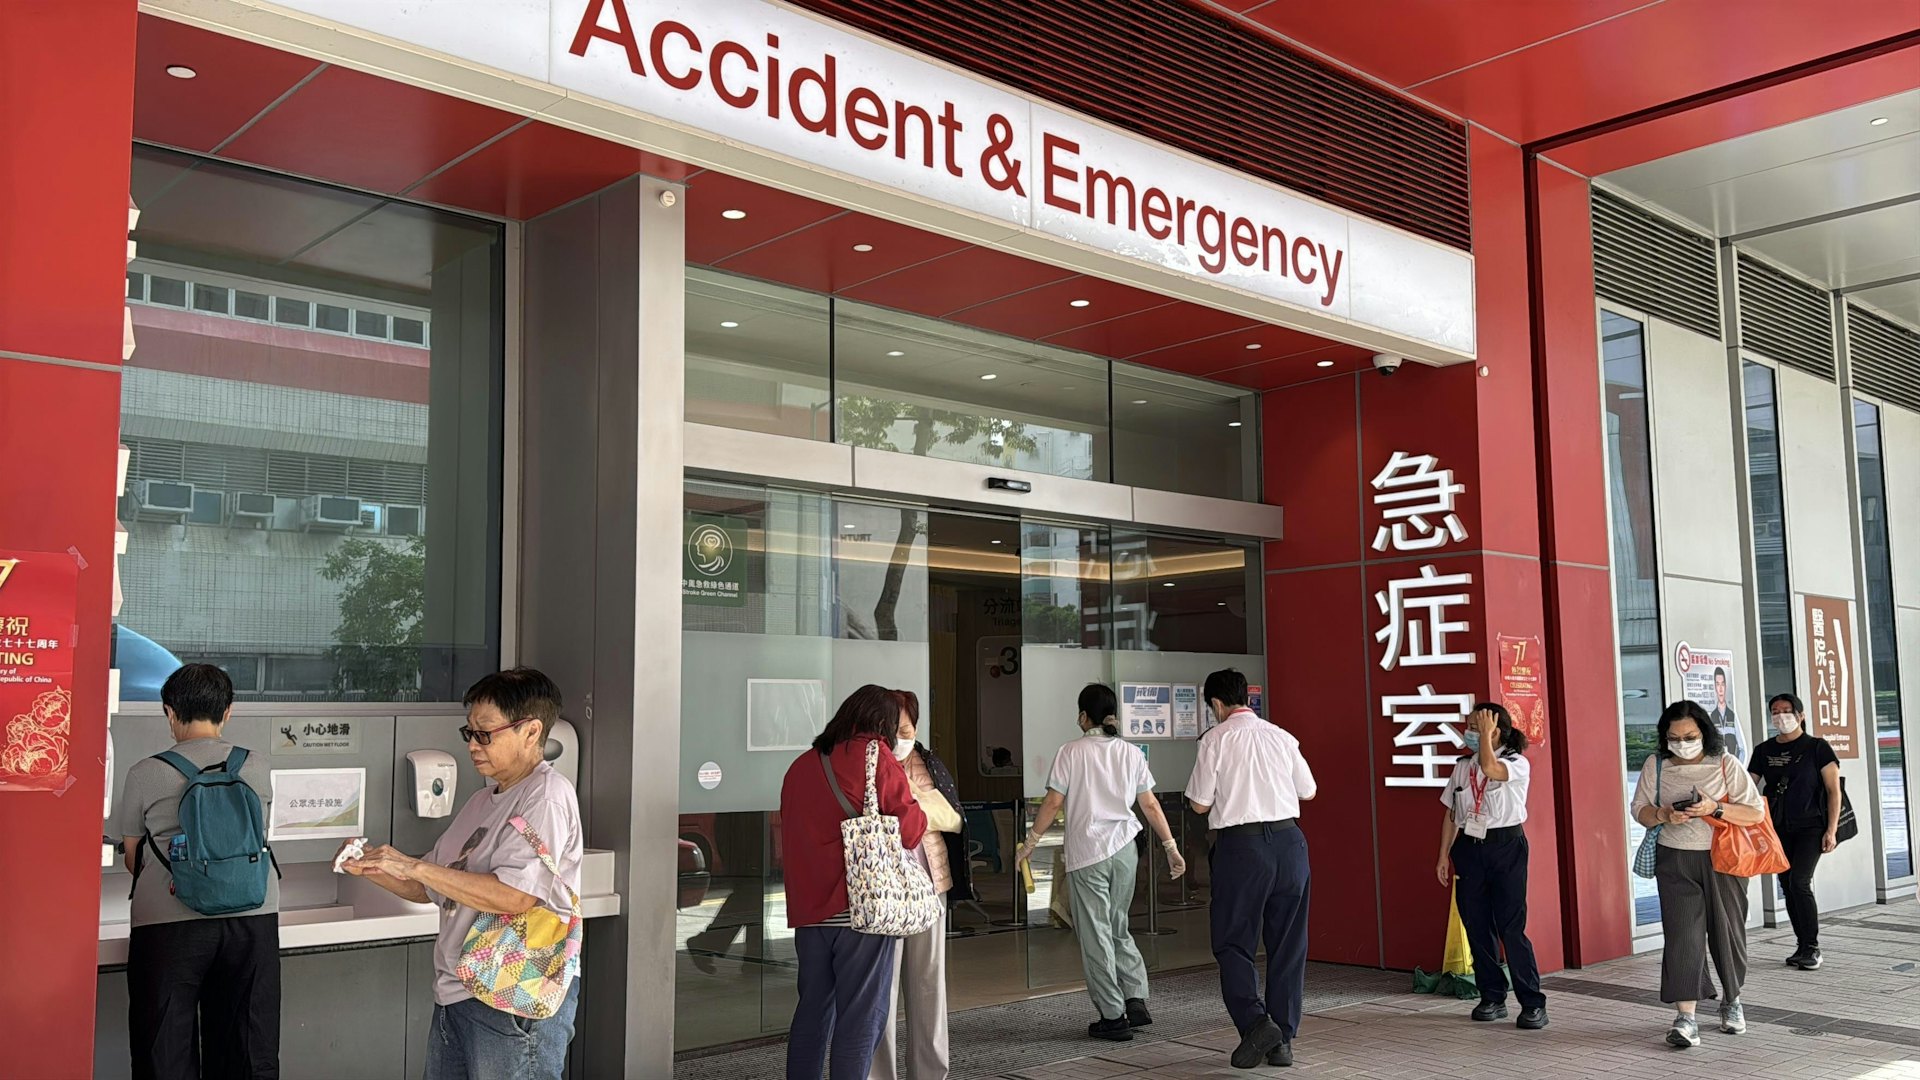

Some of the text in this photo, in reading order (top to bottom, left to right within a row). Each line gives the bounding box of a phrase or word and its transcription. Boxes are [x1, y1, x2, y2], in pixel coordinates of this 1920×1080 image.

[569, 0, 1343, 307] Accident & Emergency
[1371, 451, 1476, 787] 急症室
[0, 638, 59, 649] 七十七周年
[1000, 646, 1019, 675] 3
[303, 723, 350, 736] 小心地滑
[289, 798, 343, 808] 公眾洗手設施
